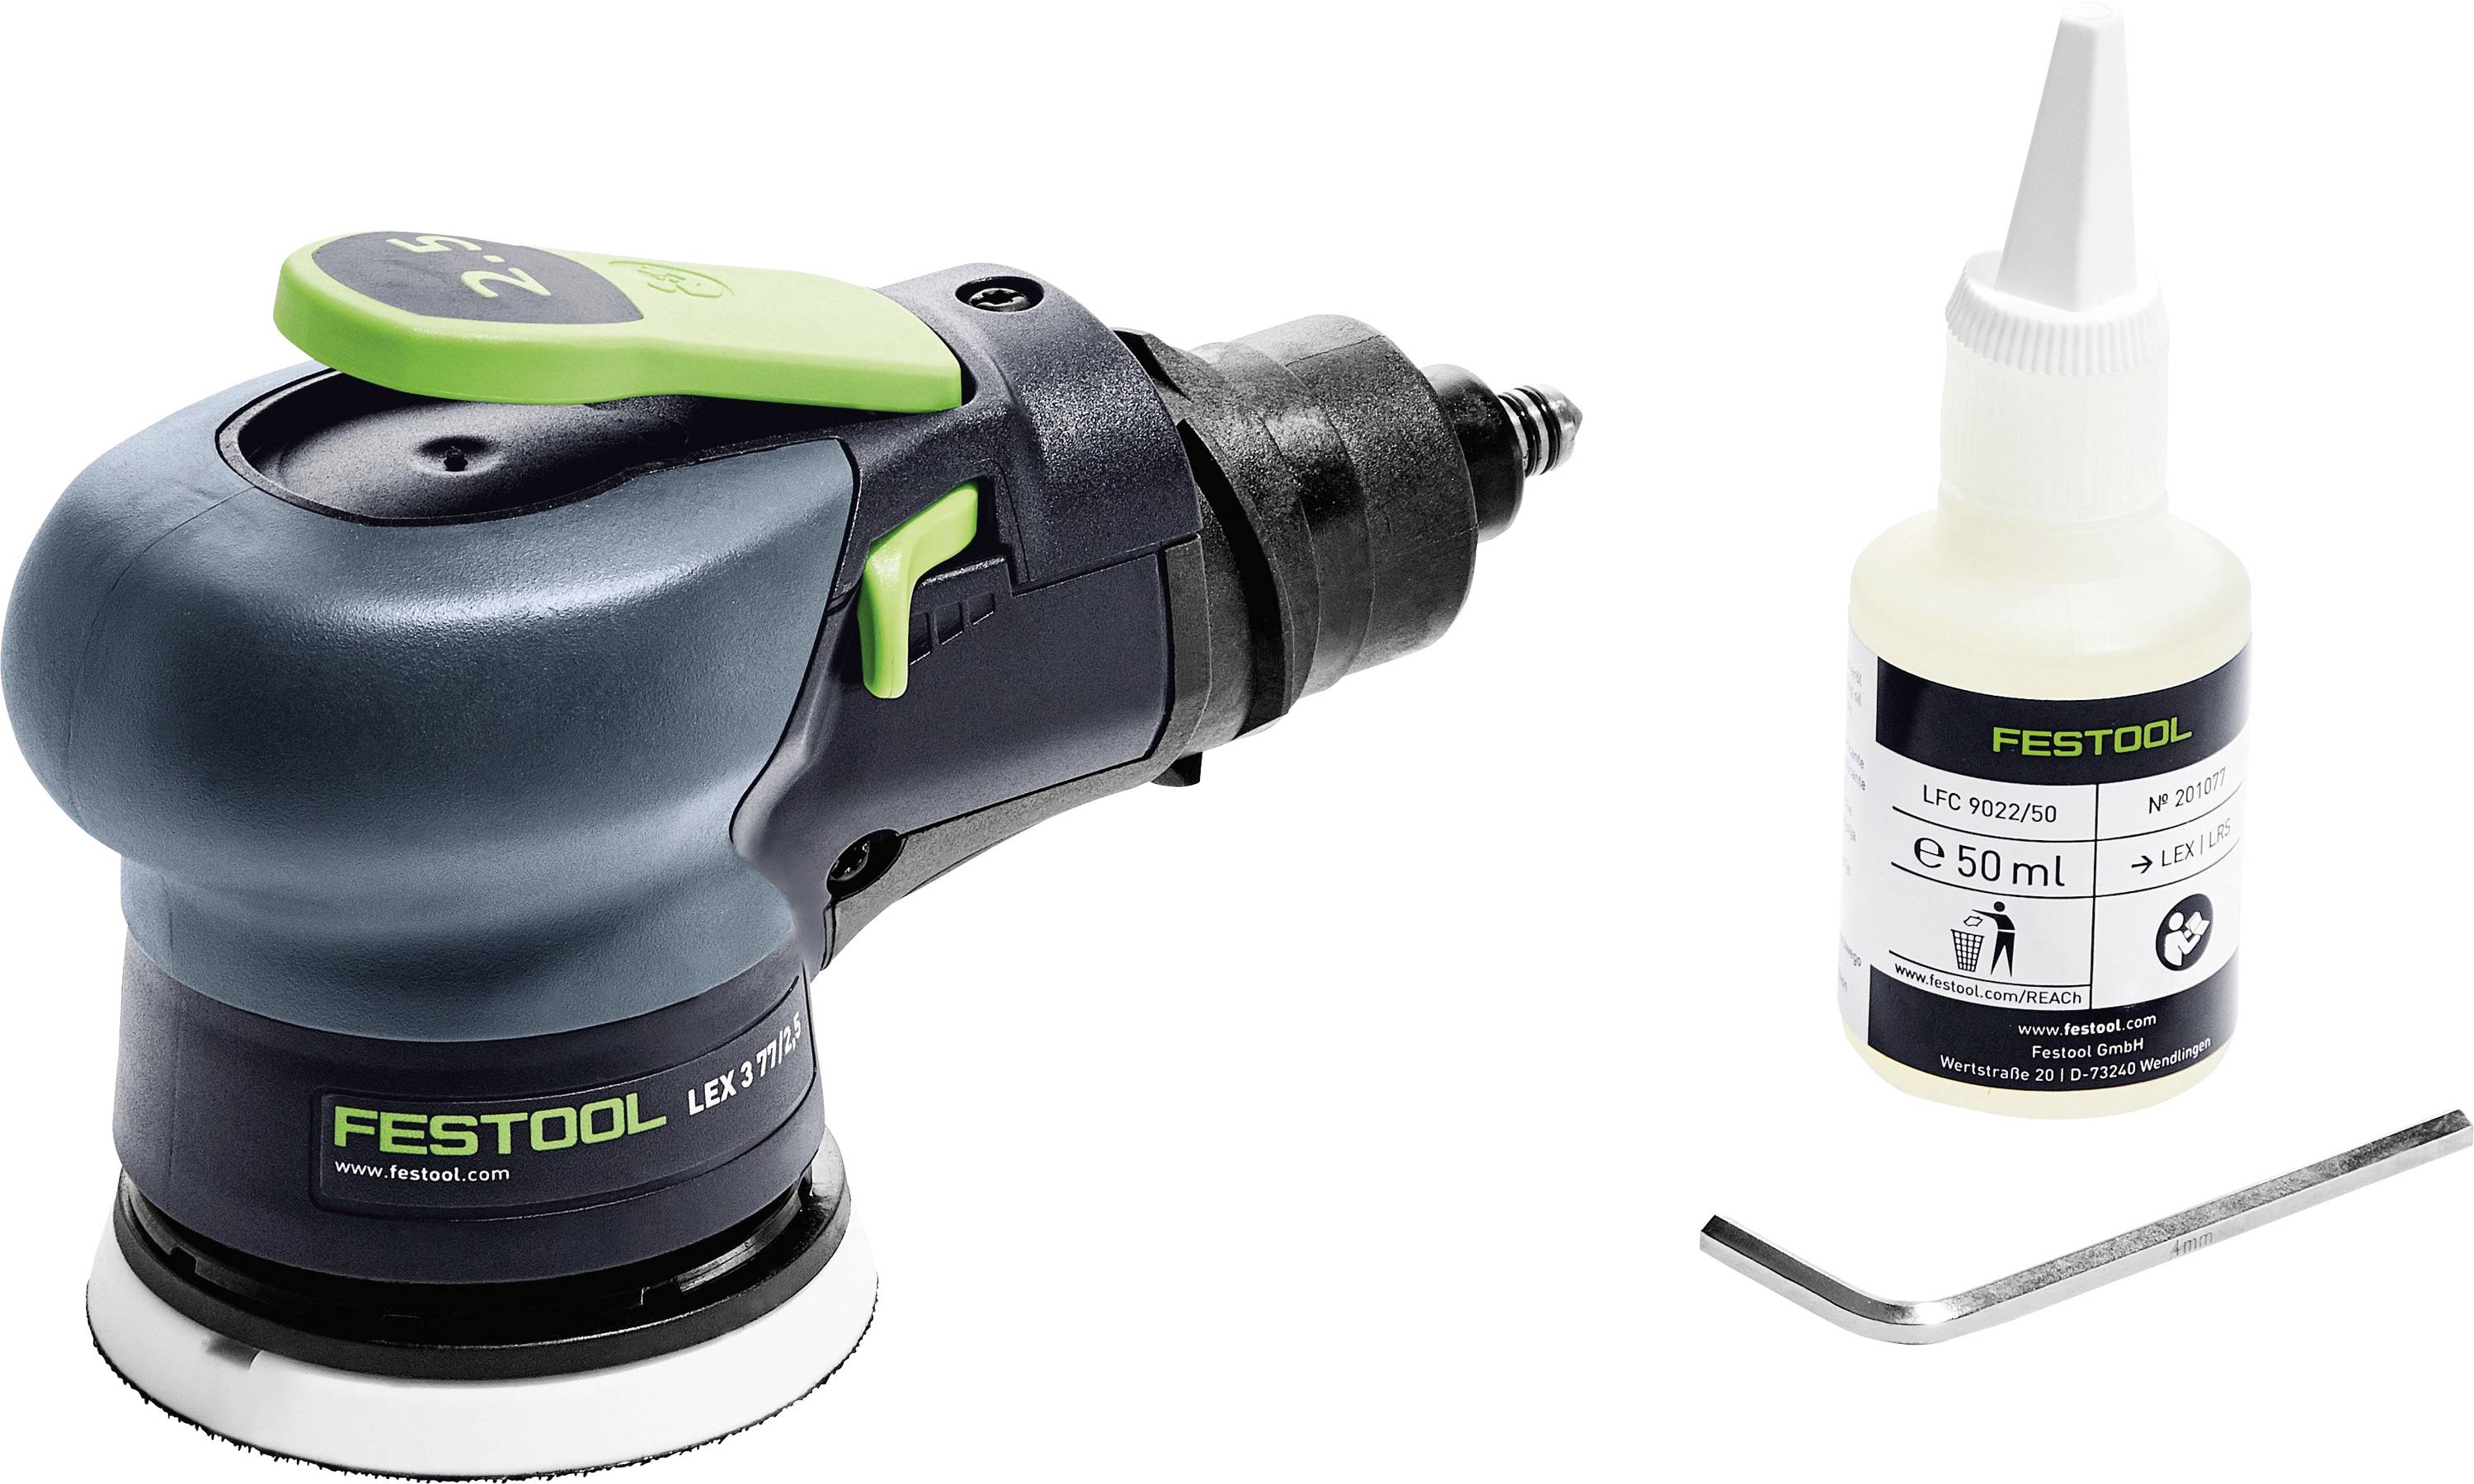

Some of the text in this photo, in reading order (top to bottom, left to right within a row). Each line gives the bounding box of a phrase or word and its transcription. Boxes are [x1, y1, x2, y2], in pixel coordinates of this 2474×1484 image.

[385, 234, 551, 298] 2.5
[1992, 716, 2194, 757] FESTOOL
[1923, 784, 2057, 824] LFC 9022/50
[2175, 767, 2227, 808] 201077
[2161, 840, 2194, 867] LEX
[2208, 818, 2232, 848] LRS
[1958, 843, 2001, 882] 50
[2012, 855, 2066, 887] ml
[1894, 963, 2082, 1005] www.festool.com/REACh
[2018, 1015, 2157, 1036] www.festool.com
[1940, 1054, 2030, 1081] Wertstraße
[2034, 1068, 2054, 1082] 20
[2070, 1061, 2136, 1082] D-73240
[2139, 1036, 2211, 1073] Wendlingen
[2032, 1037, 2144, 1059] Festool GmbH
[334, 1012, 802, 1157] FESTOOL LEX 3 77/2,5
[335, 1161, 510, 1182] www.festool.com
